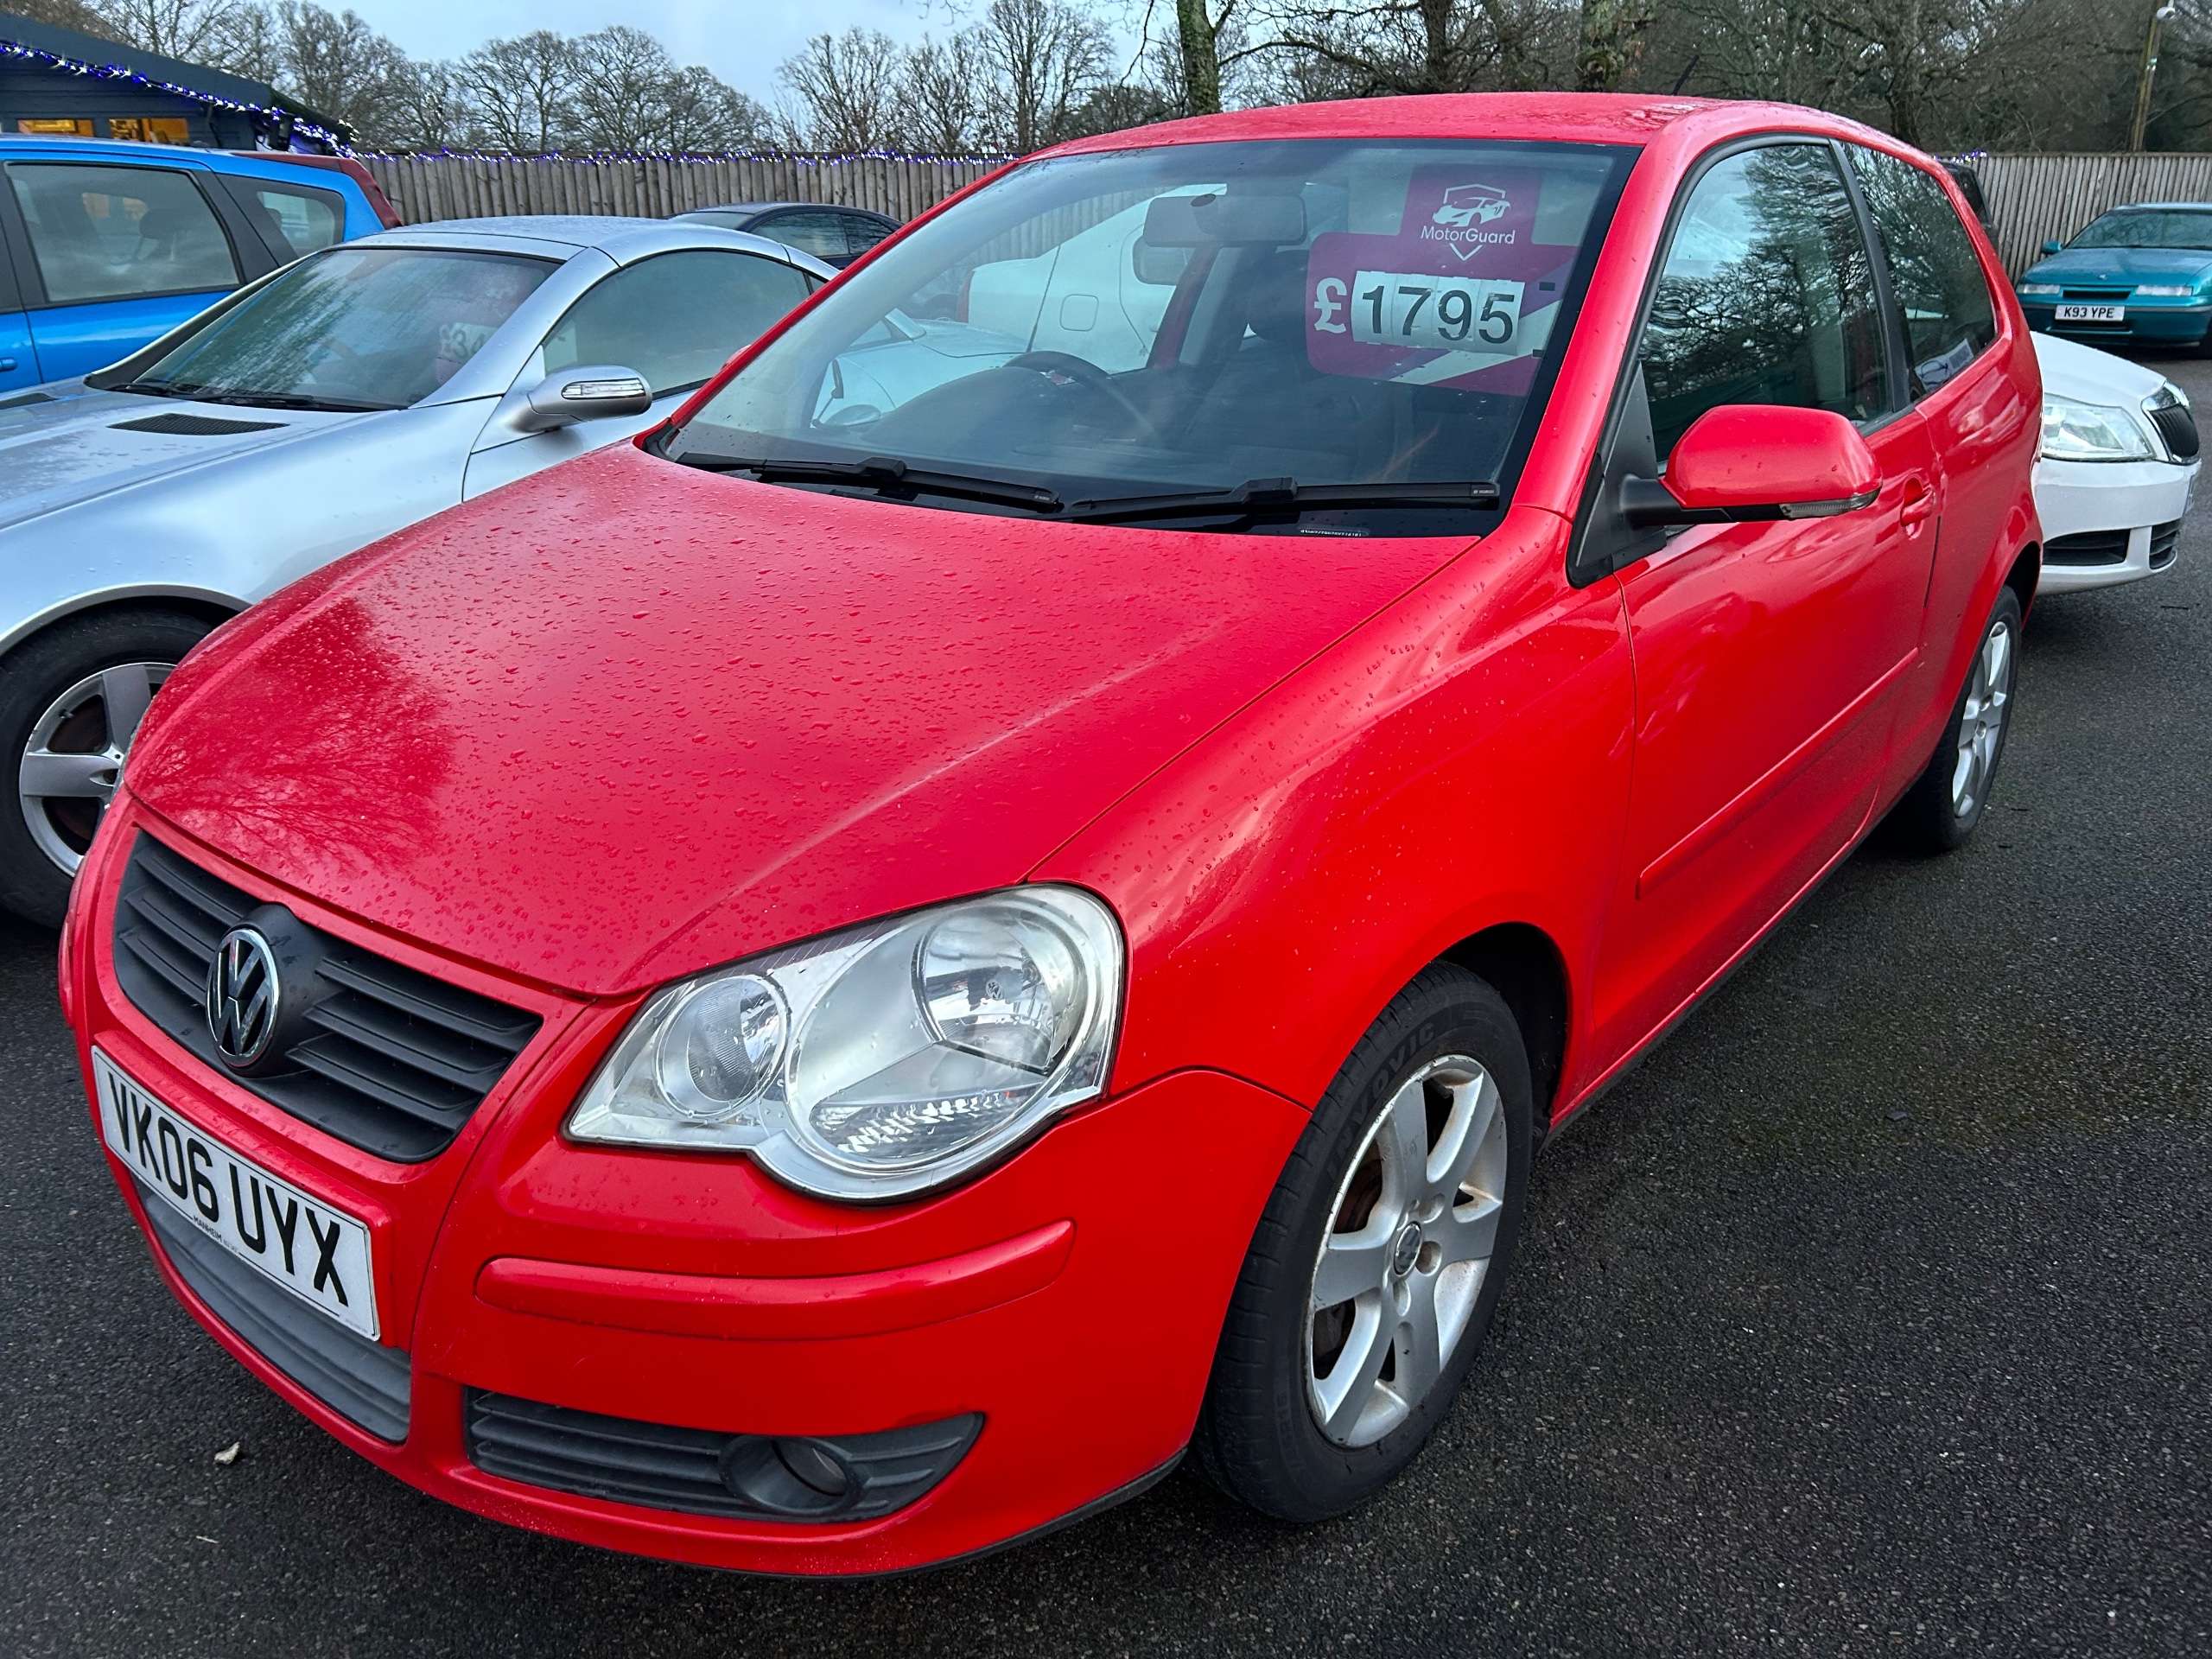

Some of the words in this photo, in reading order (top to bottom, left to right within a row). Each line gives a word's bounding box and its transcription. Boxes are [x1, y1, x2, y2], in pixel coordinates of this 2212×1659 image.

[1421, 225, 1516, 245] MotorGuard
[2063, 307, 2088, 318] K93
[2091, 307, 2115, 319] YPE
[210, 930, 278, 1065] VW
[108, 1071, 219, 1224] VK06
[228, 1161, 349, 1307] UYX
